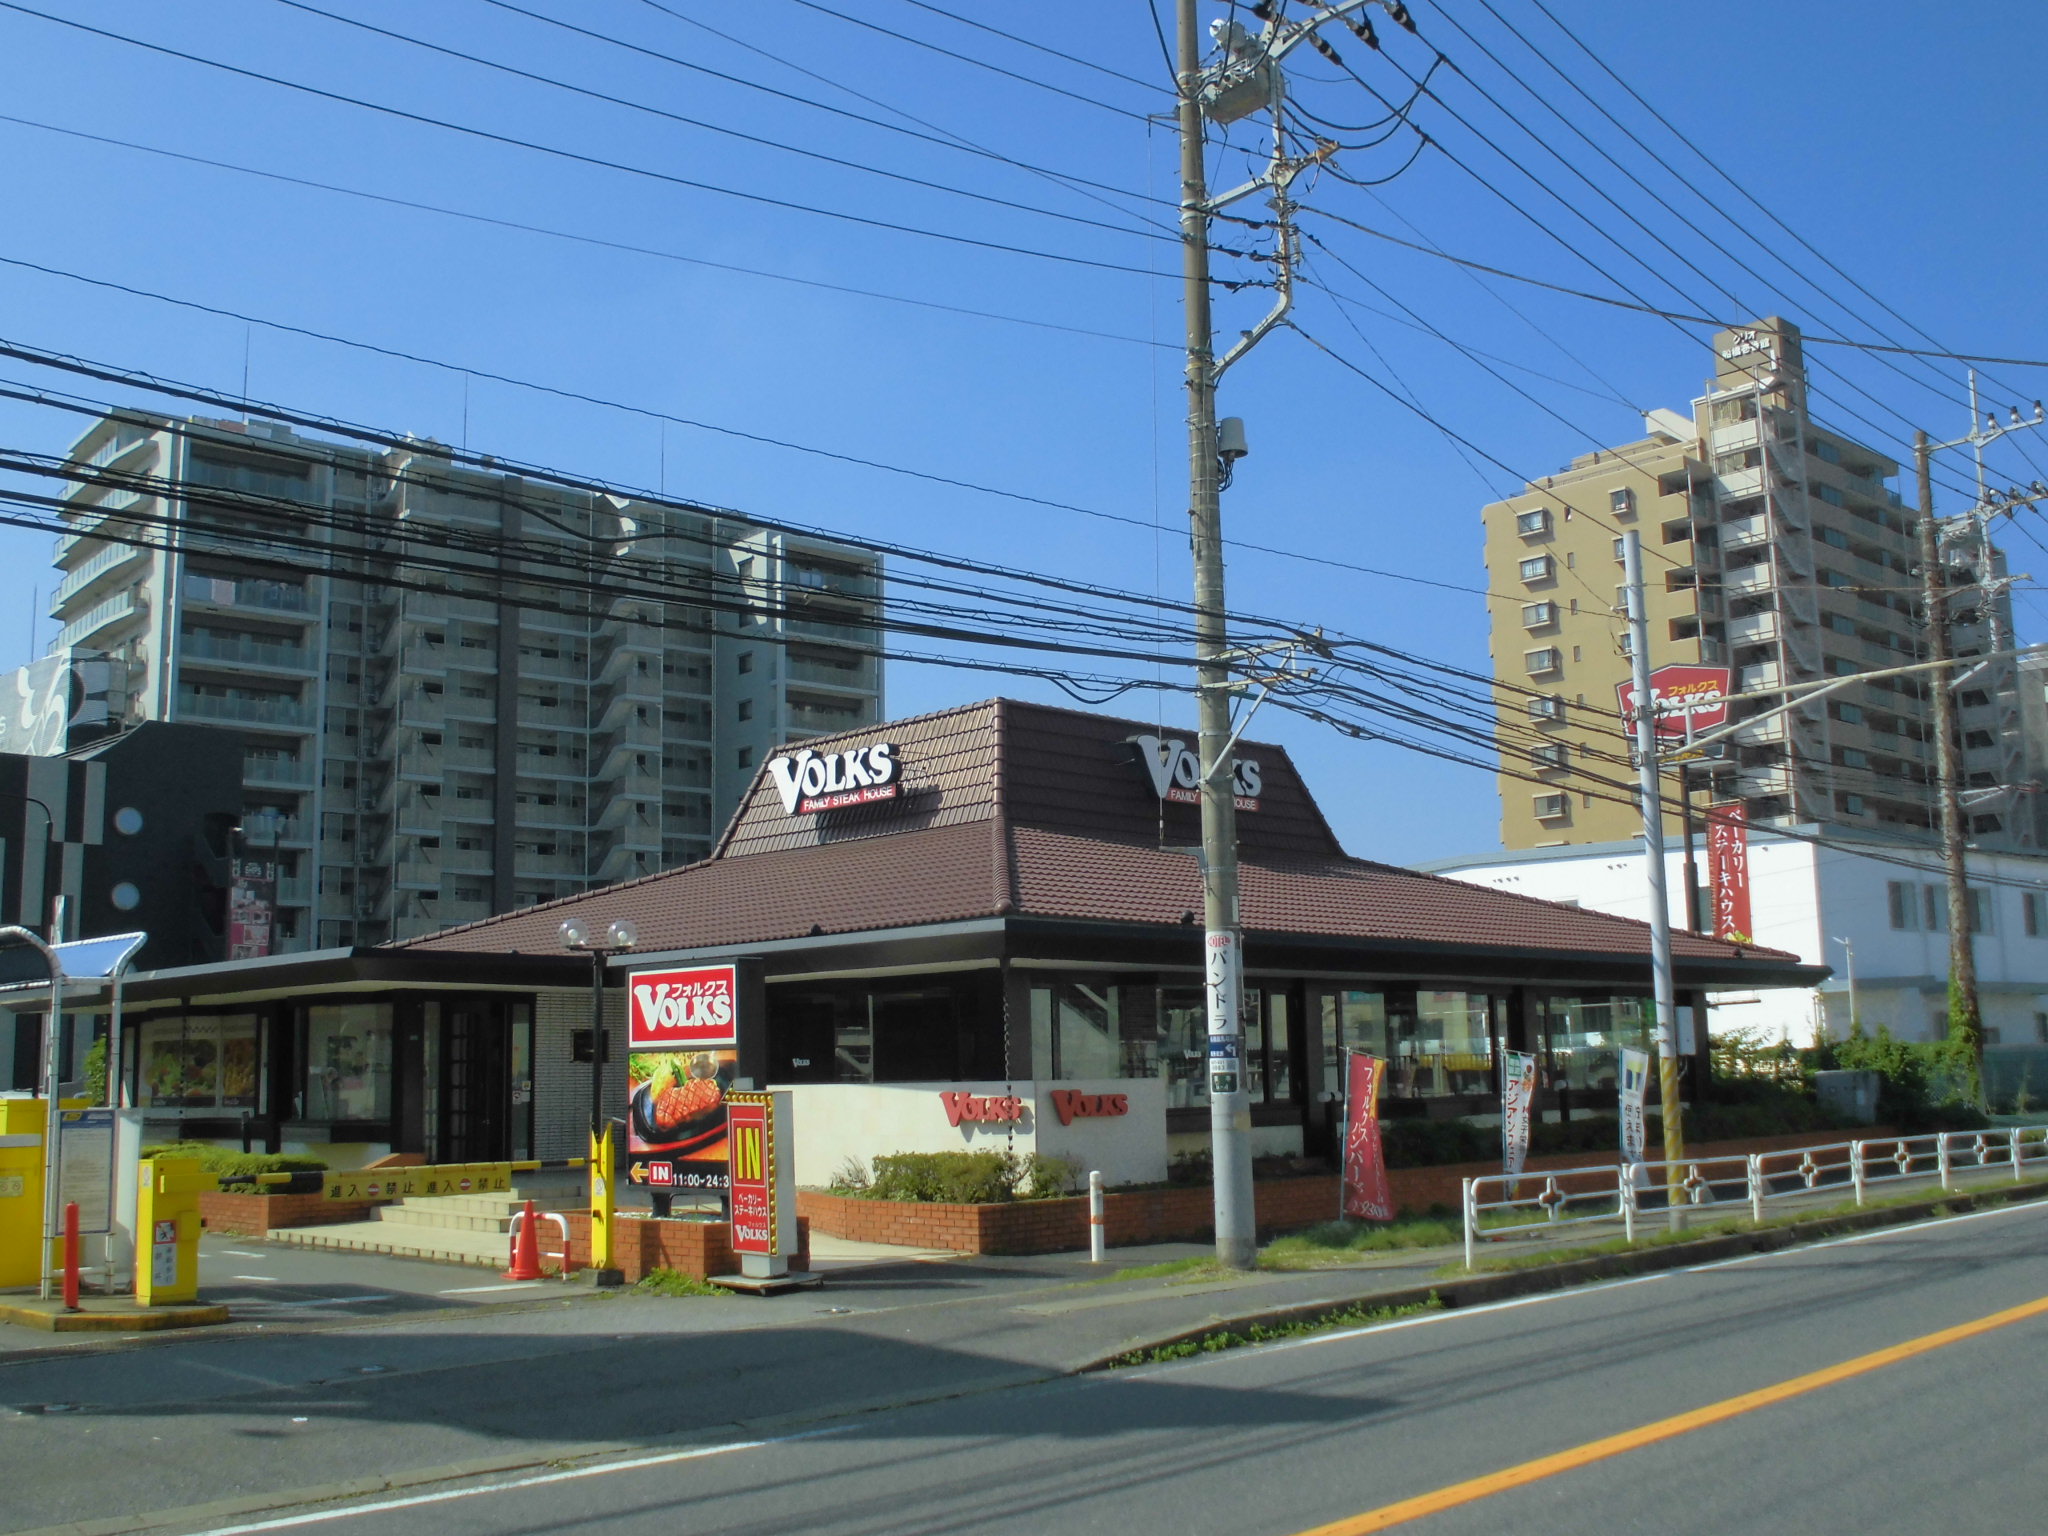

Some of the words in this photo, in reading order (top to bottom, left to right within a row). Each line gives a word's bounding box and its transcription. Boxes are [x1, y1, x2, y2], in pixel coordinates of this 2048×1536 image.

[1668, 680, 1718, 696] フォルクス
[768, 743, 893, 814] VOLKS
[804, 796, 831, 811] FAMILY
[833, 791, 860, 806] STEAK
[864, 786, 893, 800] HOUSE
[1170, 789, 1198, 802] FAMILY
[1729, 809, 1745, 888] ベーカリー
[1715, 825, 1736, 930] ステーキハウス
[671, 980, 729, 996] フォルクス
[1211, 950, 1229, 1030] パンドラ
[633, 983, 732, 1032] VOLKS
[939, 1091, 1021, 1127] VOLKS
[1050, 1089, 1129, 1126] VOLKS
[736, 1127, 761, 1180] IN
[652, 1166, 669, 1181] IN
[672, 1173, 729, 1188] 11:00~24:3
[734, 1204, 767, 1217] ステーキハウス
[738, 1193, 762, 1205] ベーカリー
[735, 1224, 767, 1242] VOLKS
